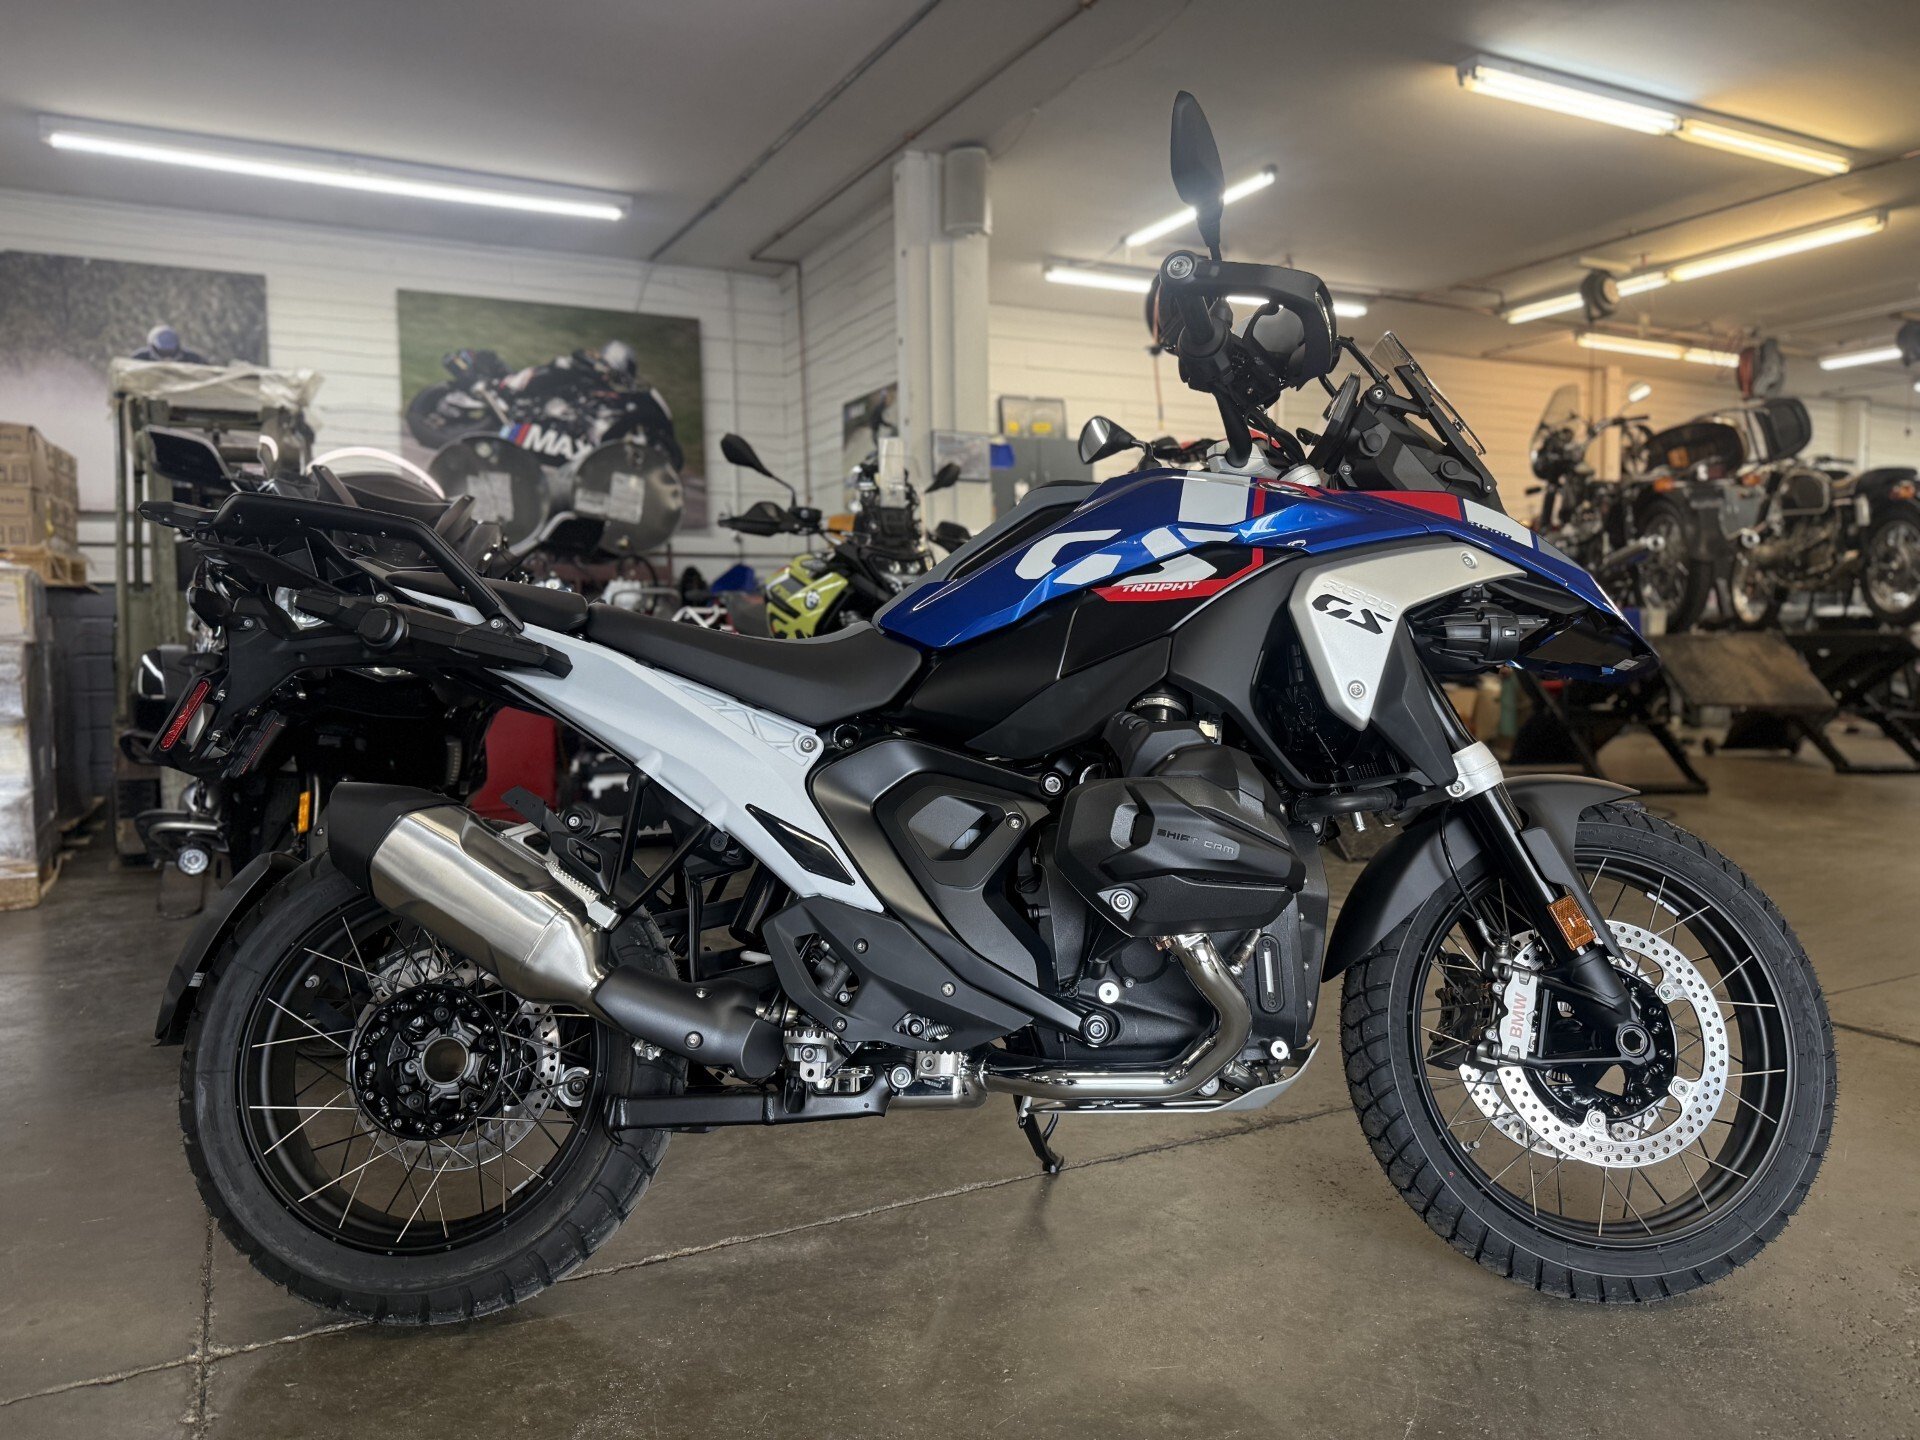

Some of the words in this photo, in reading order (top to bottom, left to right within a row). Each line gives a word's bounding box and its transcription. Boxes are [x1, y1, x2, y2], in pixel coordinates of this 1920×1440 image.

[1014, 527, 1240, 588] GS
[1121, 581, 1200, 593] TROPHY
[1311, 593, 1394, 636] GS
[1156, 827, 1200, 844] SHIFT
[1203, 840, 1235, 855] CAM
[1509, 991, 1527, 1039] BMW
